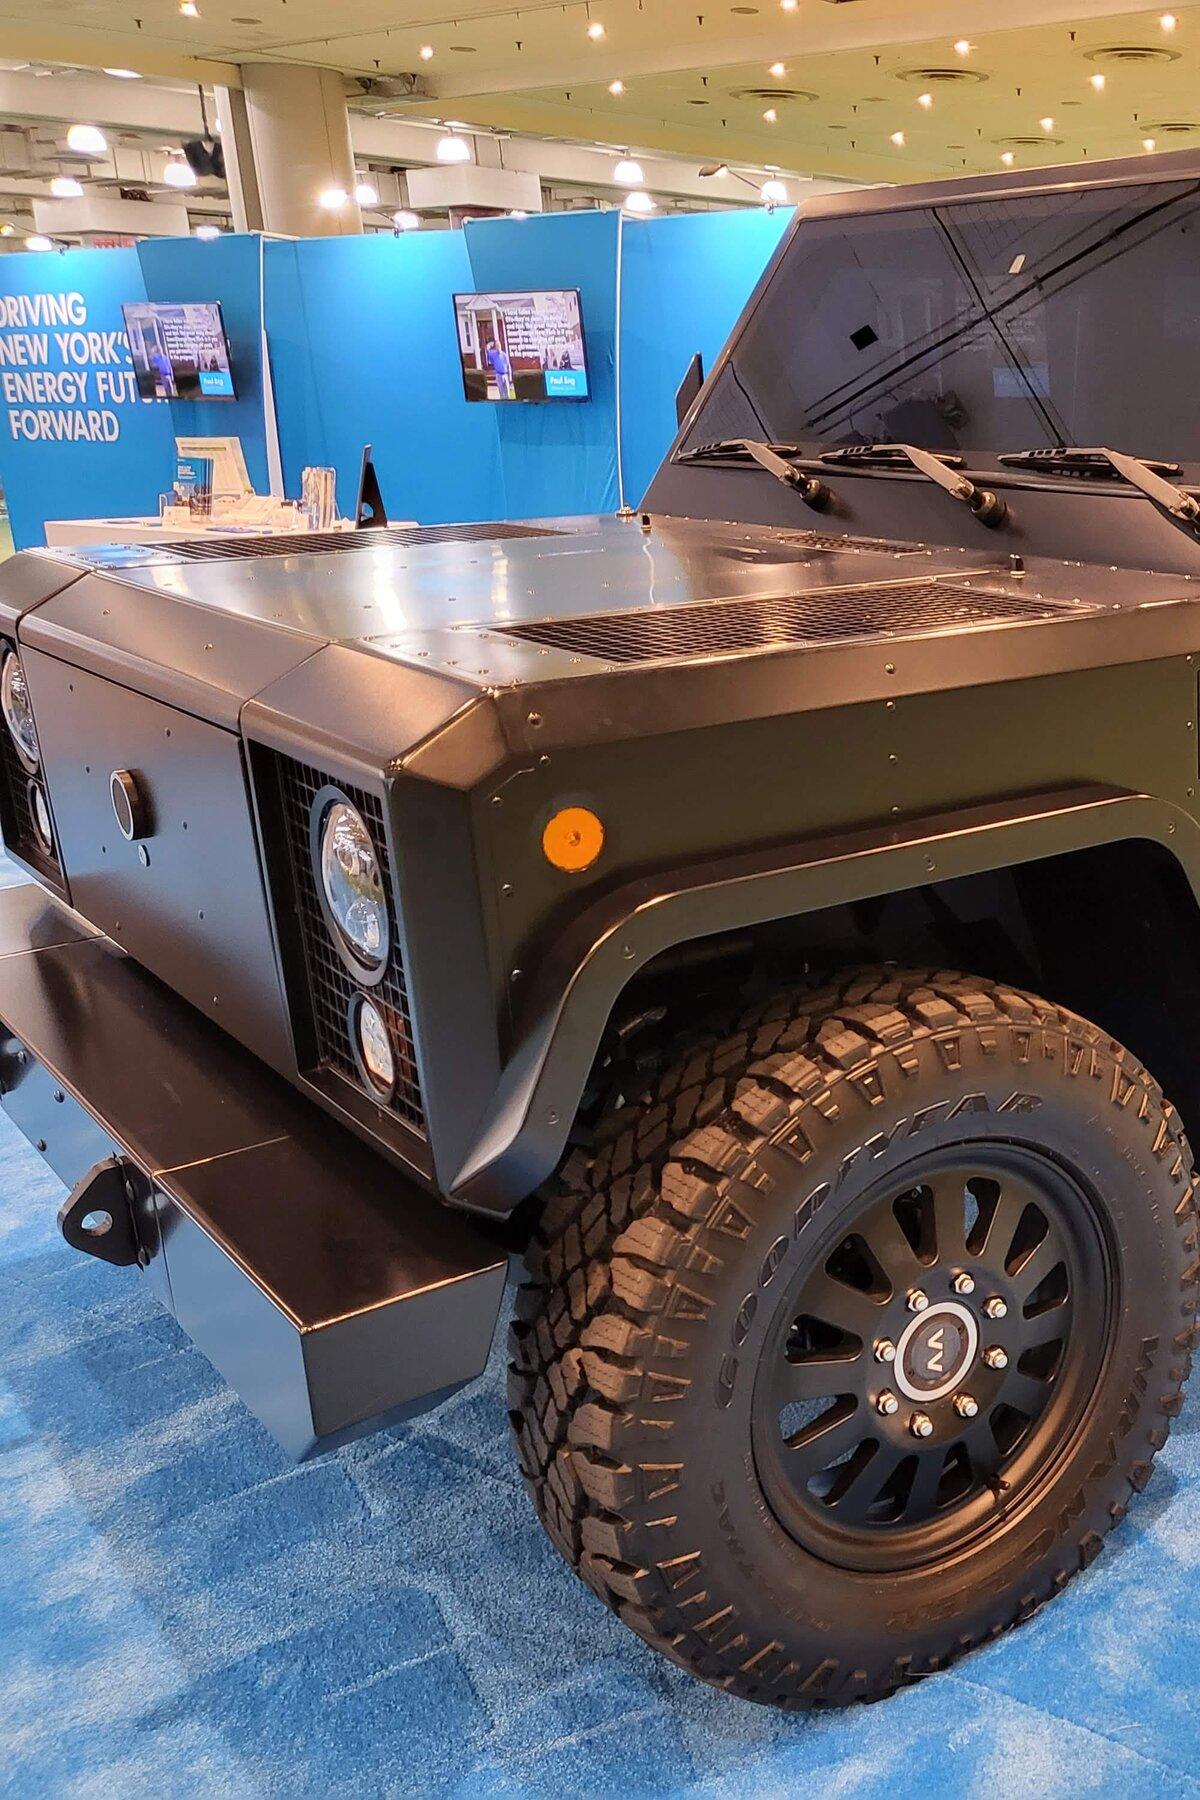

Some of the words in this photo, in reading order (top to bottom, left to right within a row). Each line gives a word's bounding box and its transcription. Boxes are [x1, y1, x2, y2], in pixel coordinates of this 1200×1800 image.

[0, 332, 48, 366] NEW
[2, 371, 88, 404] ENERGY
[96, 371, 169, 404] FUT
[9, 409, 119, 442] FORWARD
